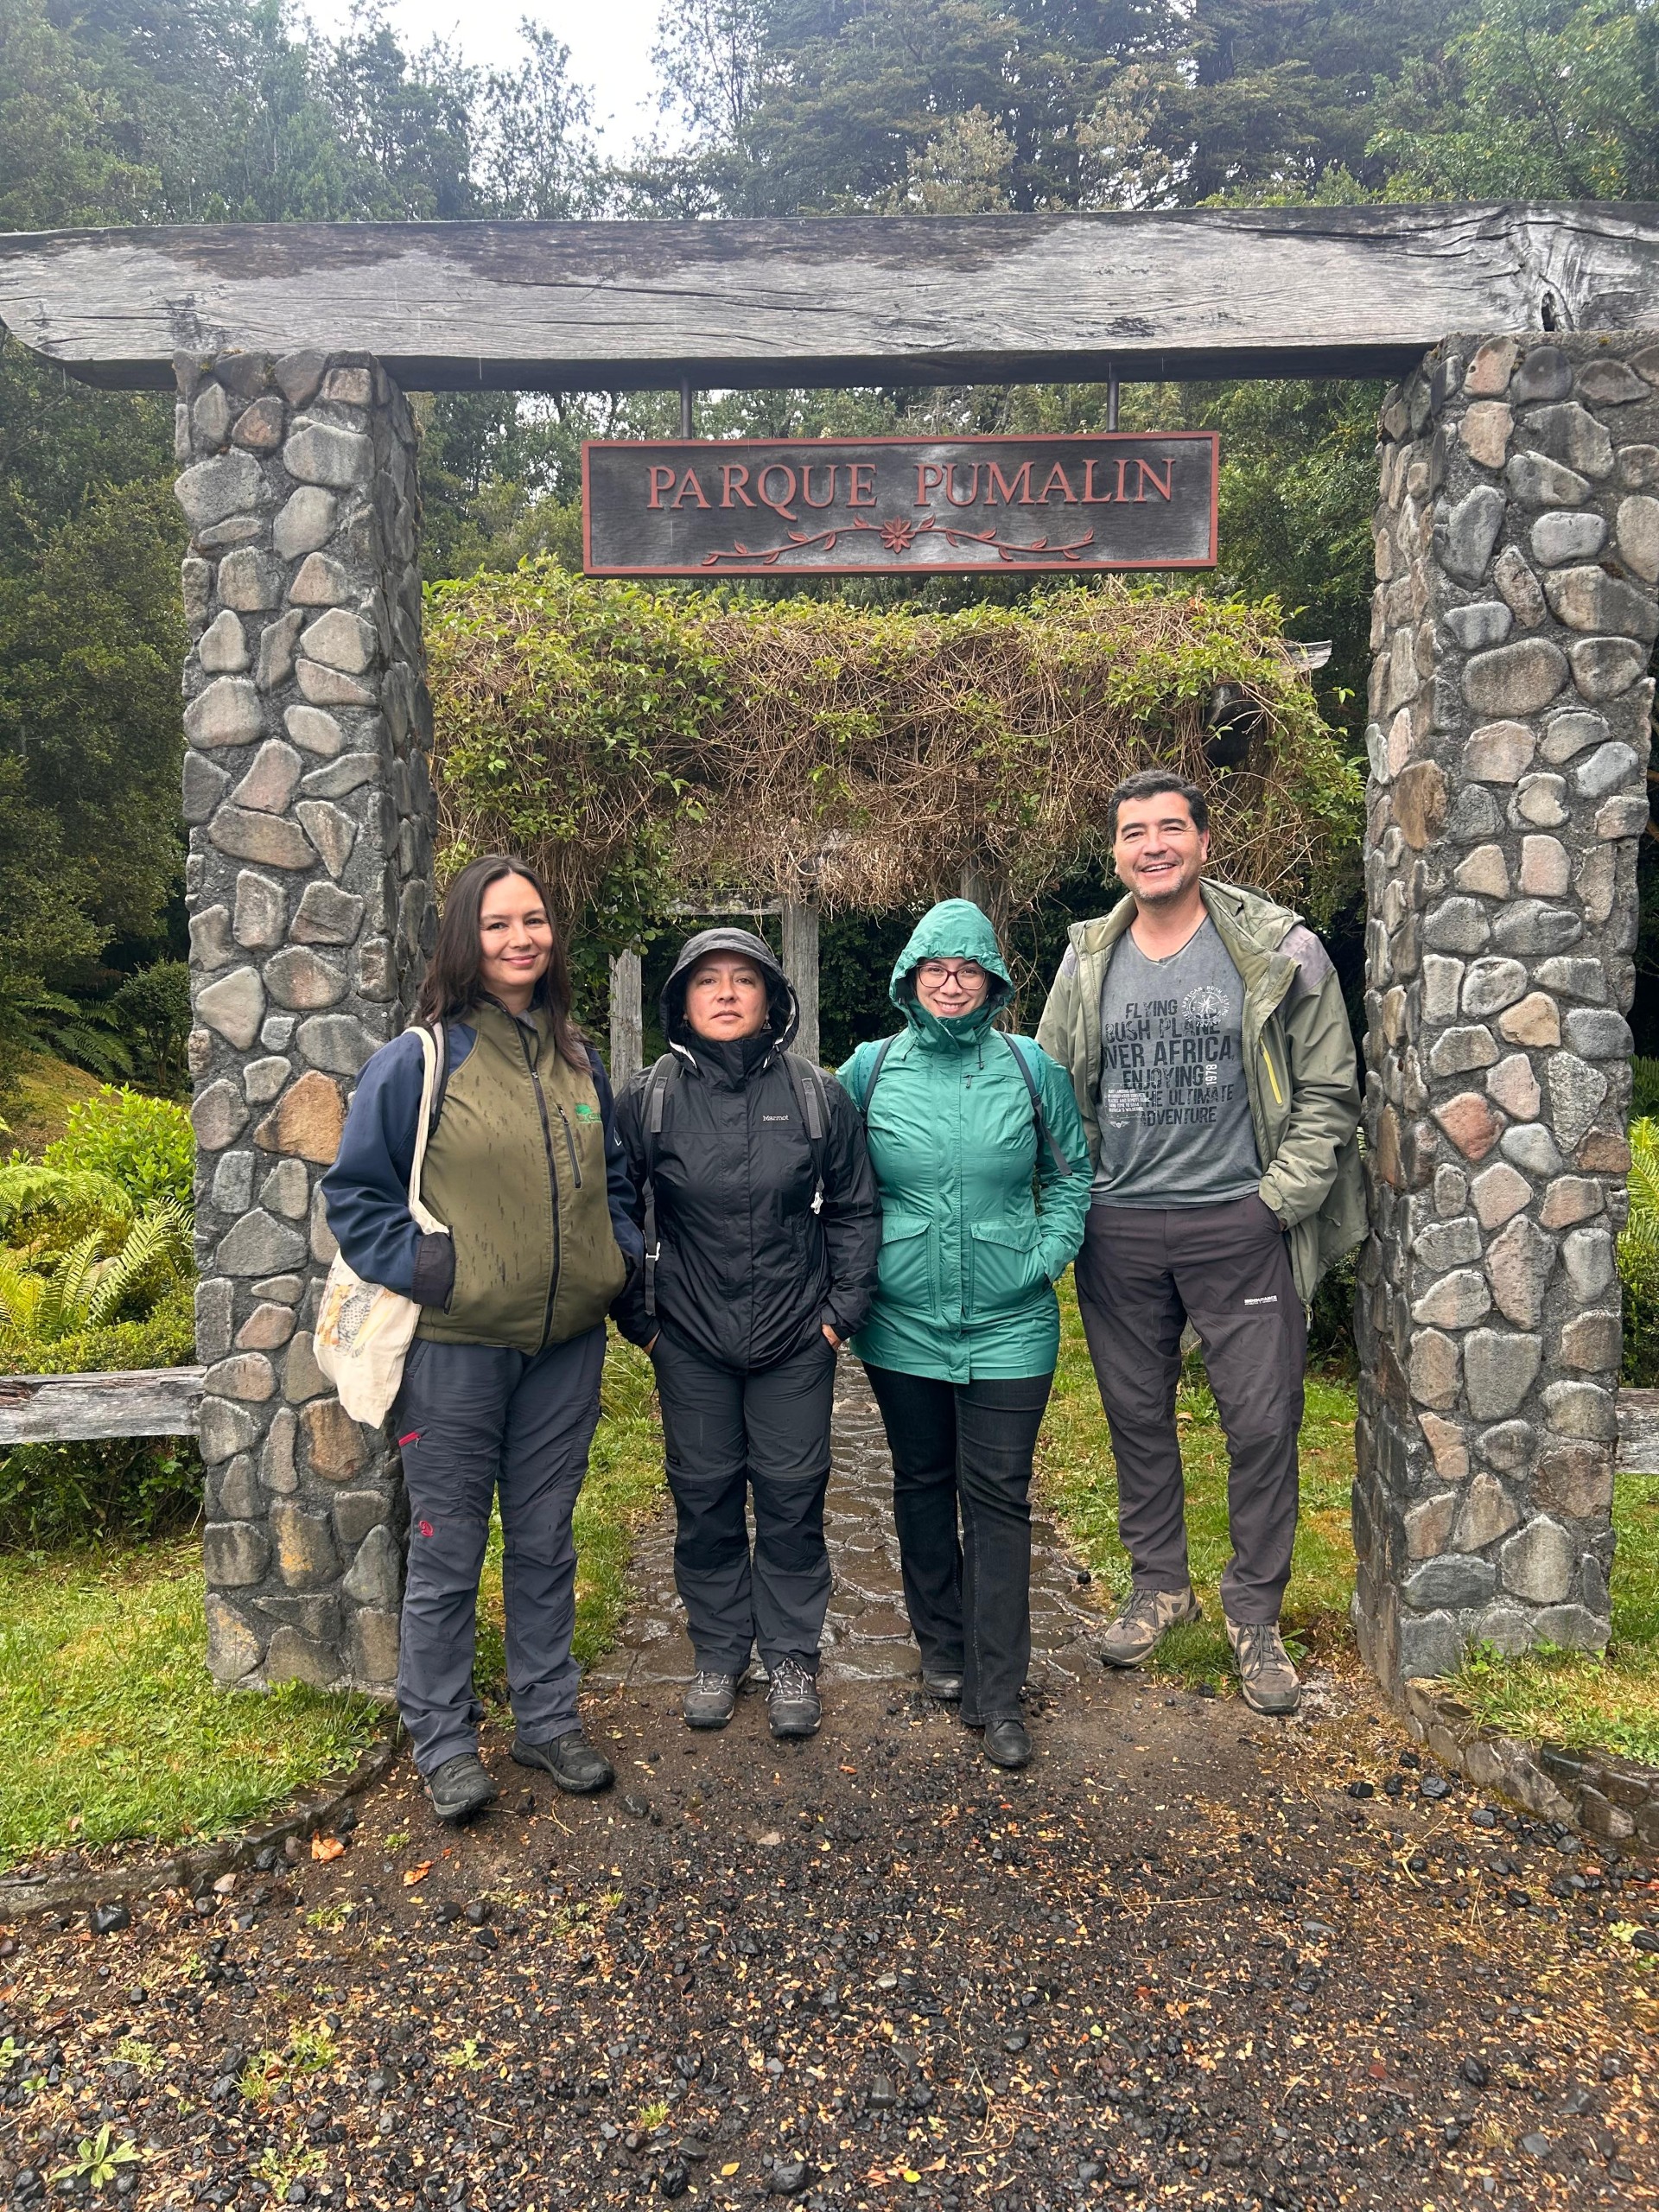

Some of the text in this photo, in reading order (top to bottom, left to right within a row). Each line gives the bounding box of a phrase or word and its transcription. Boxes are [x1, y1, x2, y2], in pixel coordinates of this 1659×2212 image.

[646, 457, 1178, 521] PARQUE PUMALIN
[1125, 999, 1178, 1019] FLYING
[1105, 1019, 1151, 1043] BUSH
[1154, 1035, 1235, 1067] AFRICA,
[1123, 1065, 1205, 1090] ENJOYING
[1205, 1064, 1217, 1086] 1978
[1169, 1084, 1235, 1106] ULTIMATE
[1140, 1106, 1217, 1127] ADVENTURE
